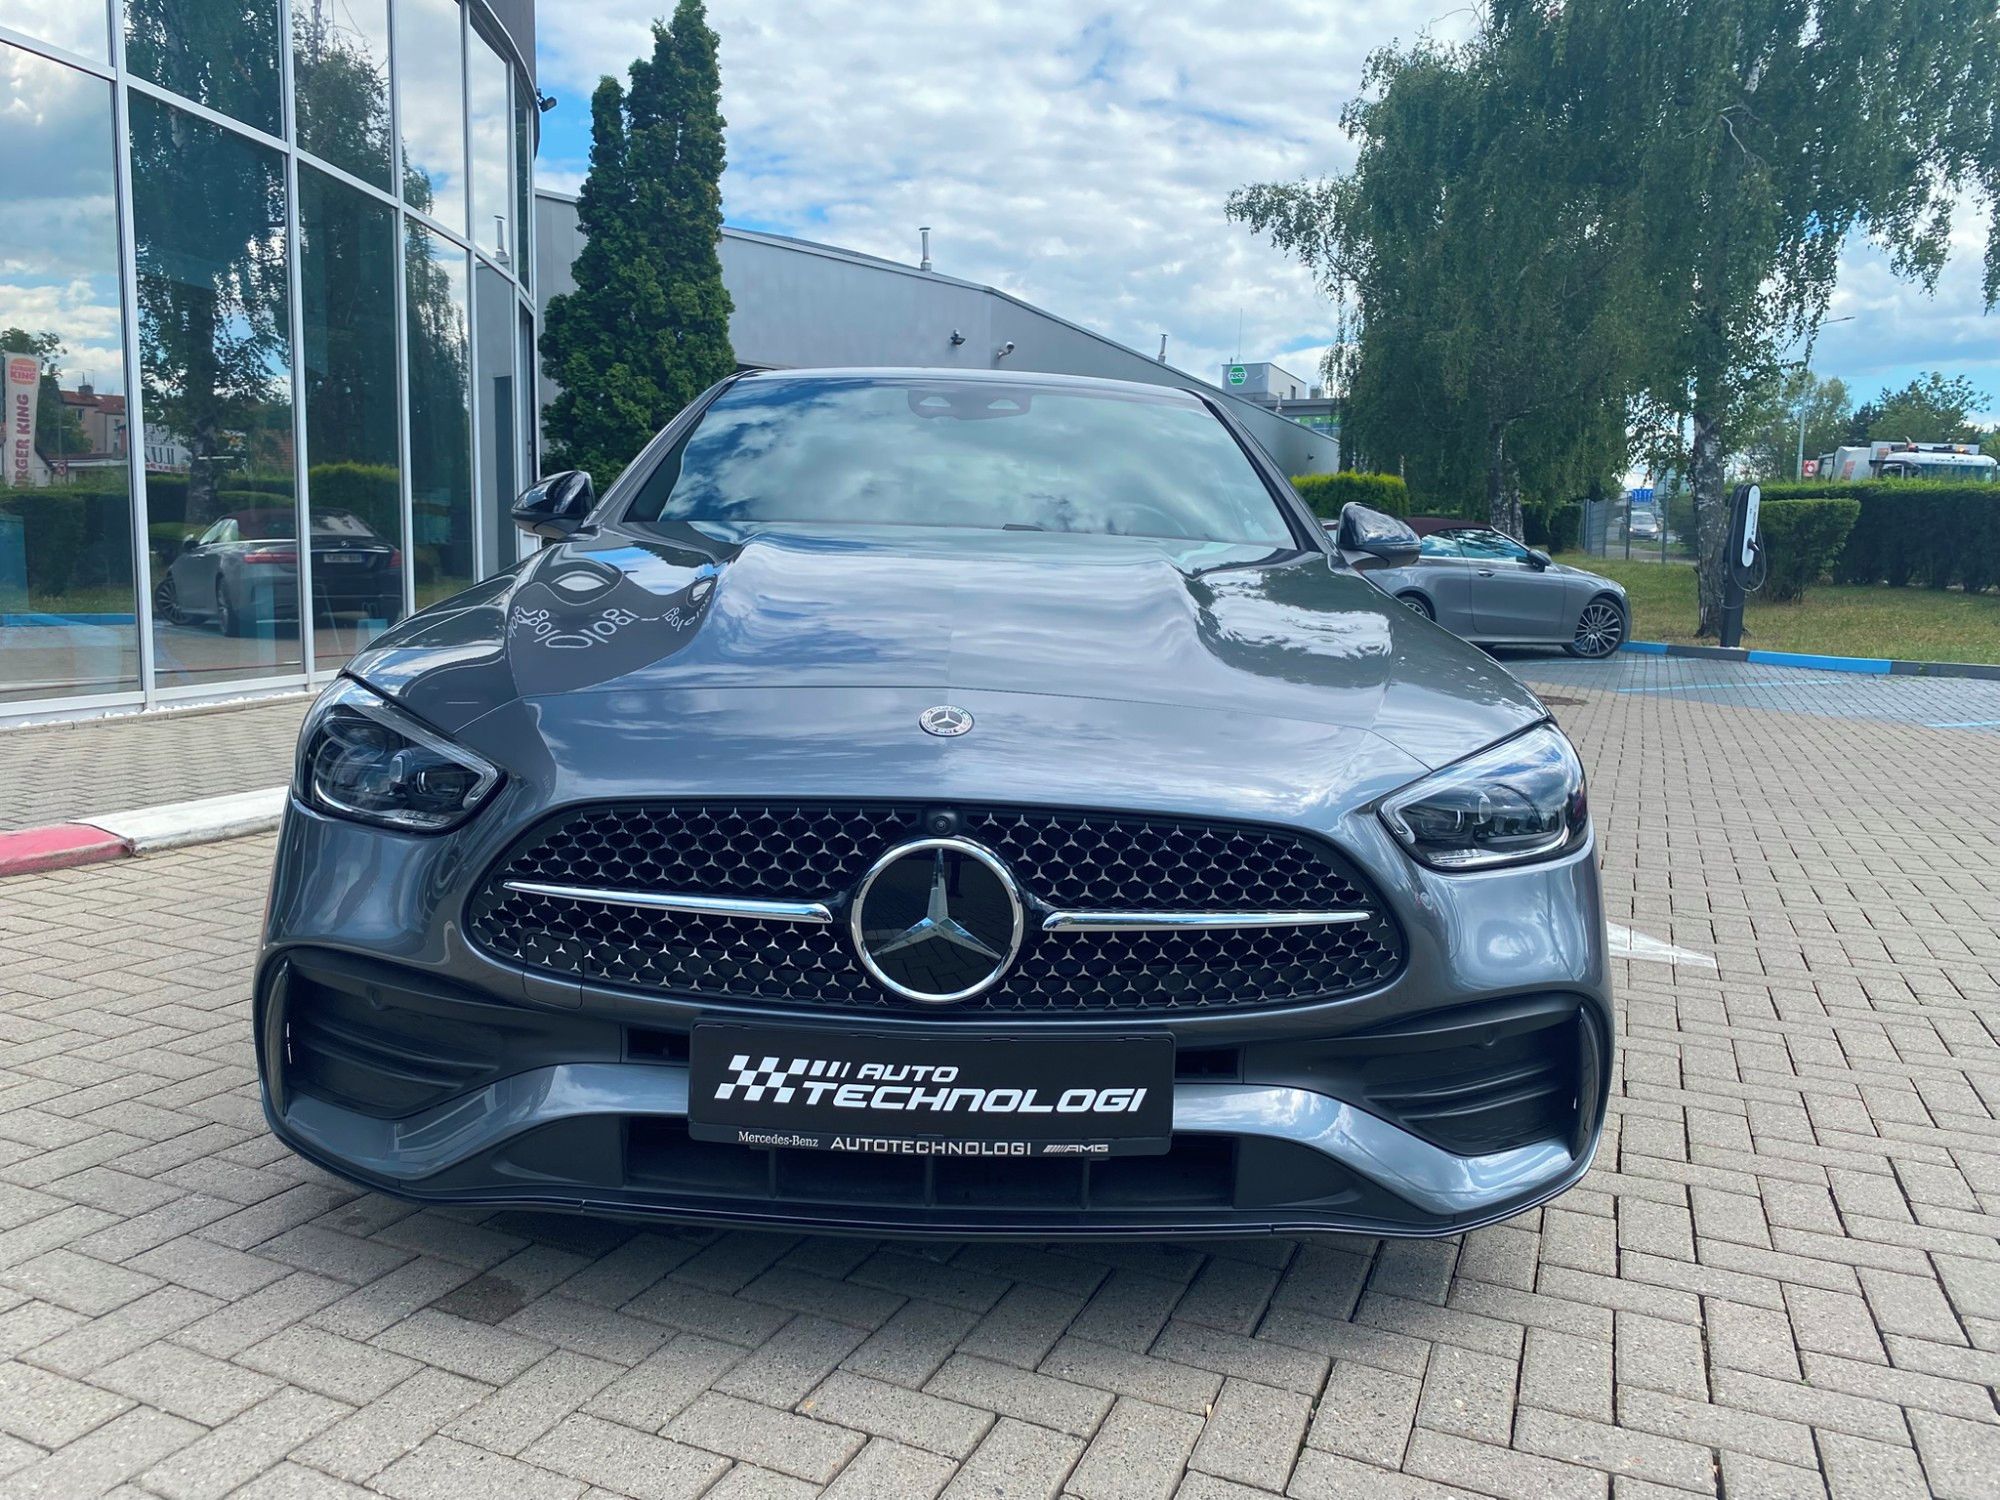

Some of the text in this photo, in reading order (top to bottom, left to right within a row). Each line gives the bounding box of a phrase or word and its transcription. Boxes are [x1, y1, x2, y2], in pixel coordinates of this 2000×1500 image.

[15, 394, 31, 488] URGER KING
[856, 1063, 960, 1083] AUTO
[802, 1080, 1149, 1113] TECHNOLOGI
[738, 1131, 1109, 1156] Mercedes-Benz AUTOTECHNOLOGI AMG
